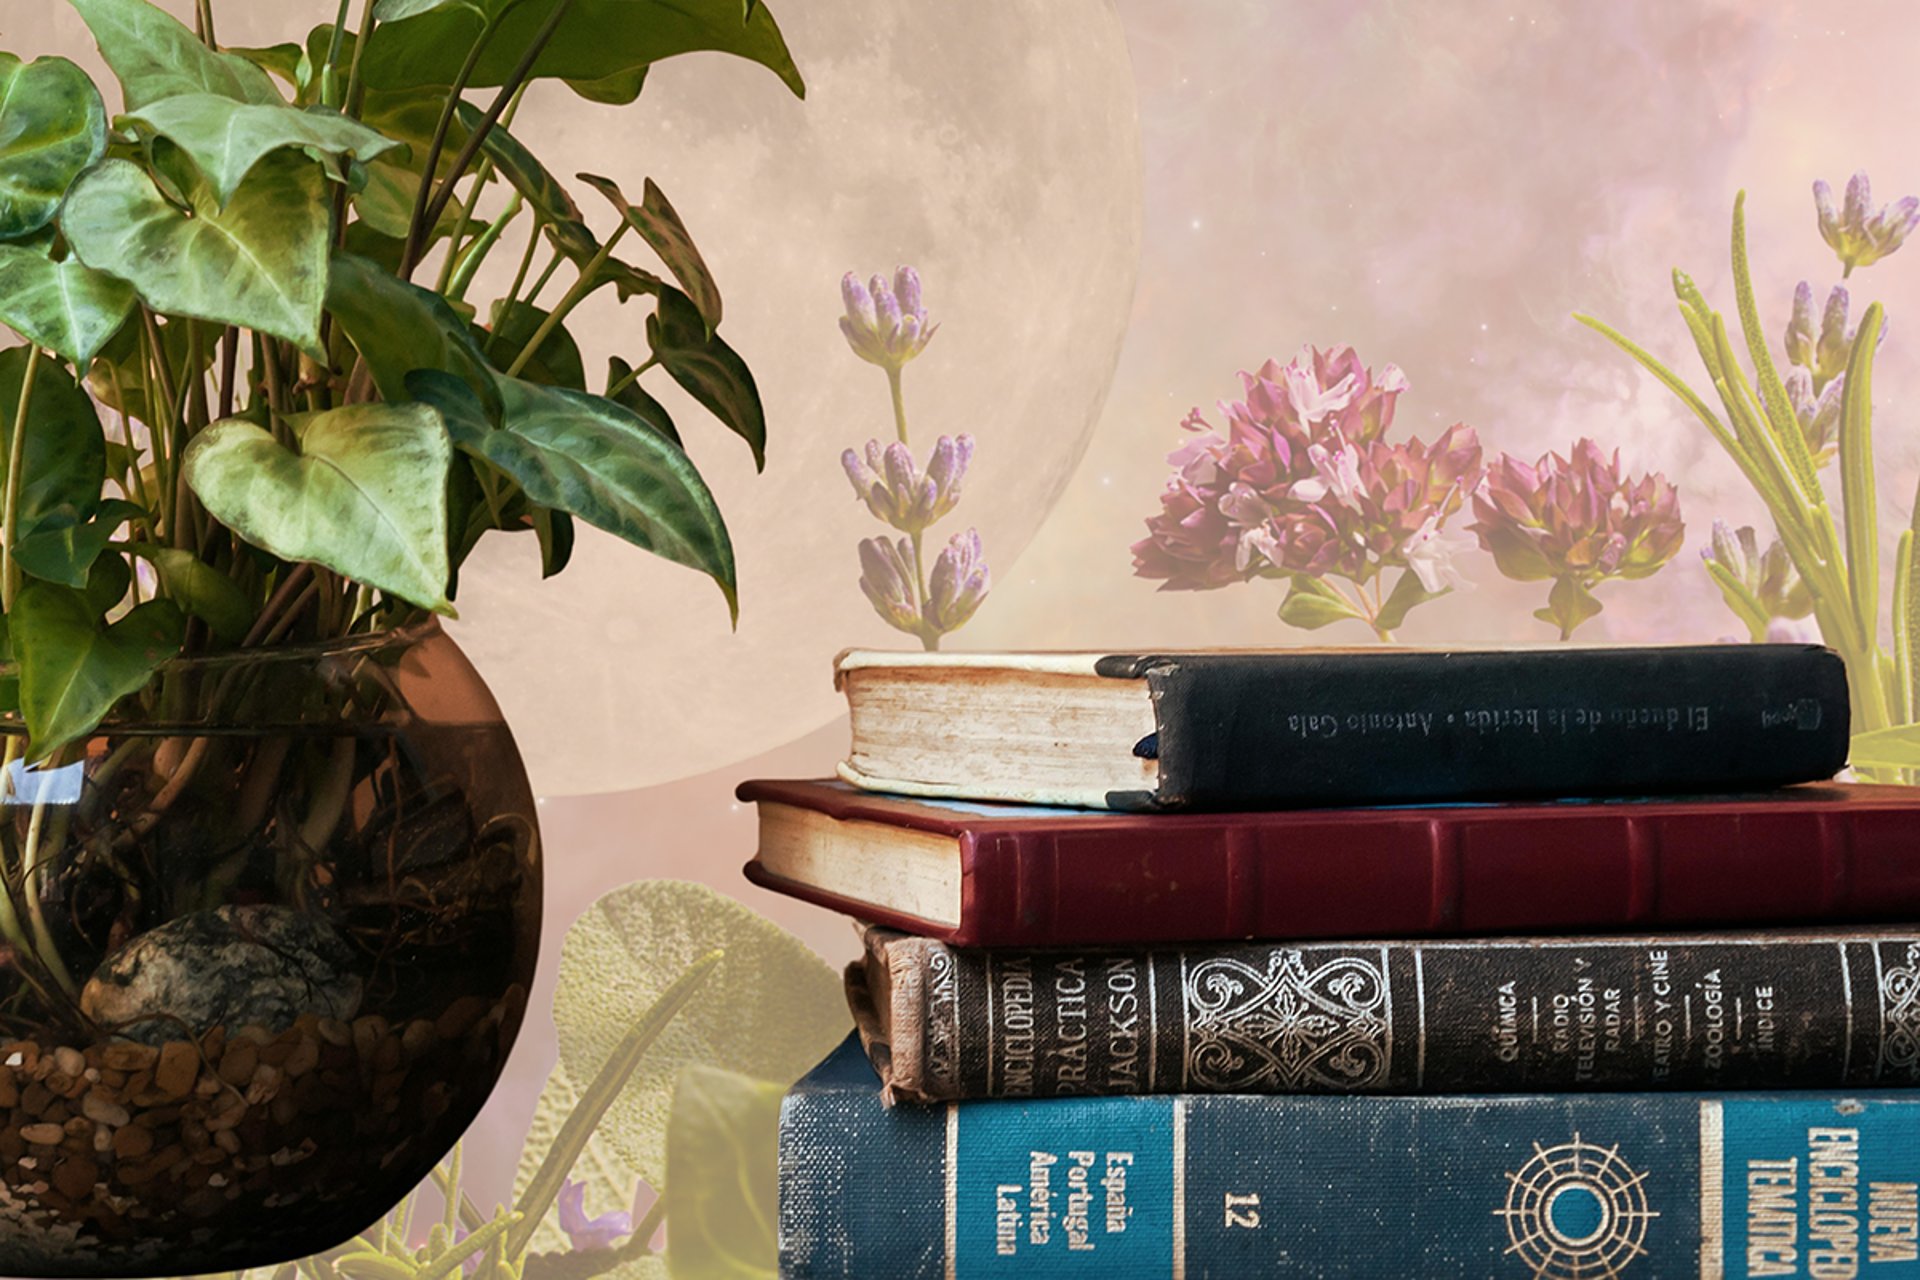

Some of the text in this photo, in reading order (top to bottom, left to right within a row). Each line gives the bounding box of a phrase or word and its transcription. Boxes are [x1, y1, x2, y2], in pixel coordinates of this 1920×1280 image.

[1288, 706, 1709, 738] El dueño de la herida Antonio Gala
[1650, 950, 1671, 996] CINE
[1655, 1000, 1672, 1014] Y
[1003, 956, 1035, 1096] ENCICLOPEDIA
[1047, 957, 1088, 1095] PRÁCTICA
[1106, 958, 1139, 1092] JACKSON
[1553, 993, 1570, 1052] RADIO
[1570, 978, 1596, 1082] TELEVISIÓN
[1604, 987, 1621, 1051] RADAR
[1696, 968, 1724, 1069] ZOOLOGÍA
[996, 1184, 1023, 1256] Latina
[1029, 1151, 1059, 1245] América
[1062, 1150, 1096, 1251] Portugal
[1100, 1151, 1133, 1233] España
[1225, 1192, 1261, 1229] 12
[1747, 1156, 1798, 1278] TEMATICA
[1868, 1181, 1919, 1263] NUEVA
